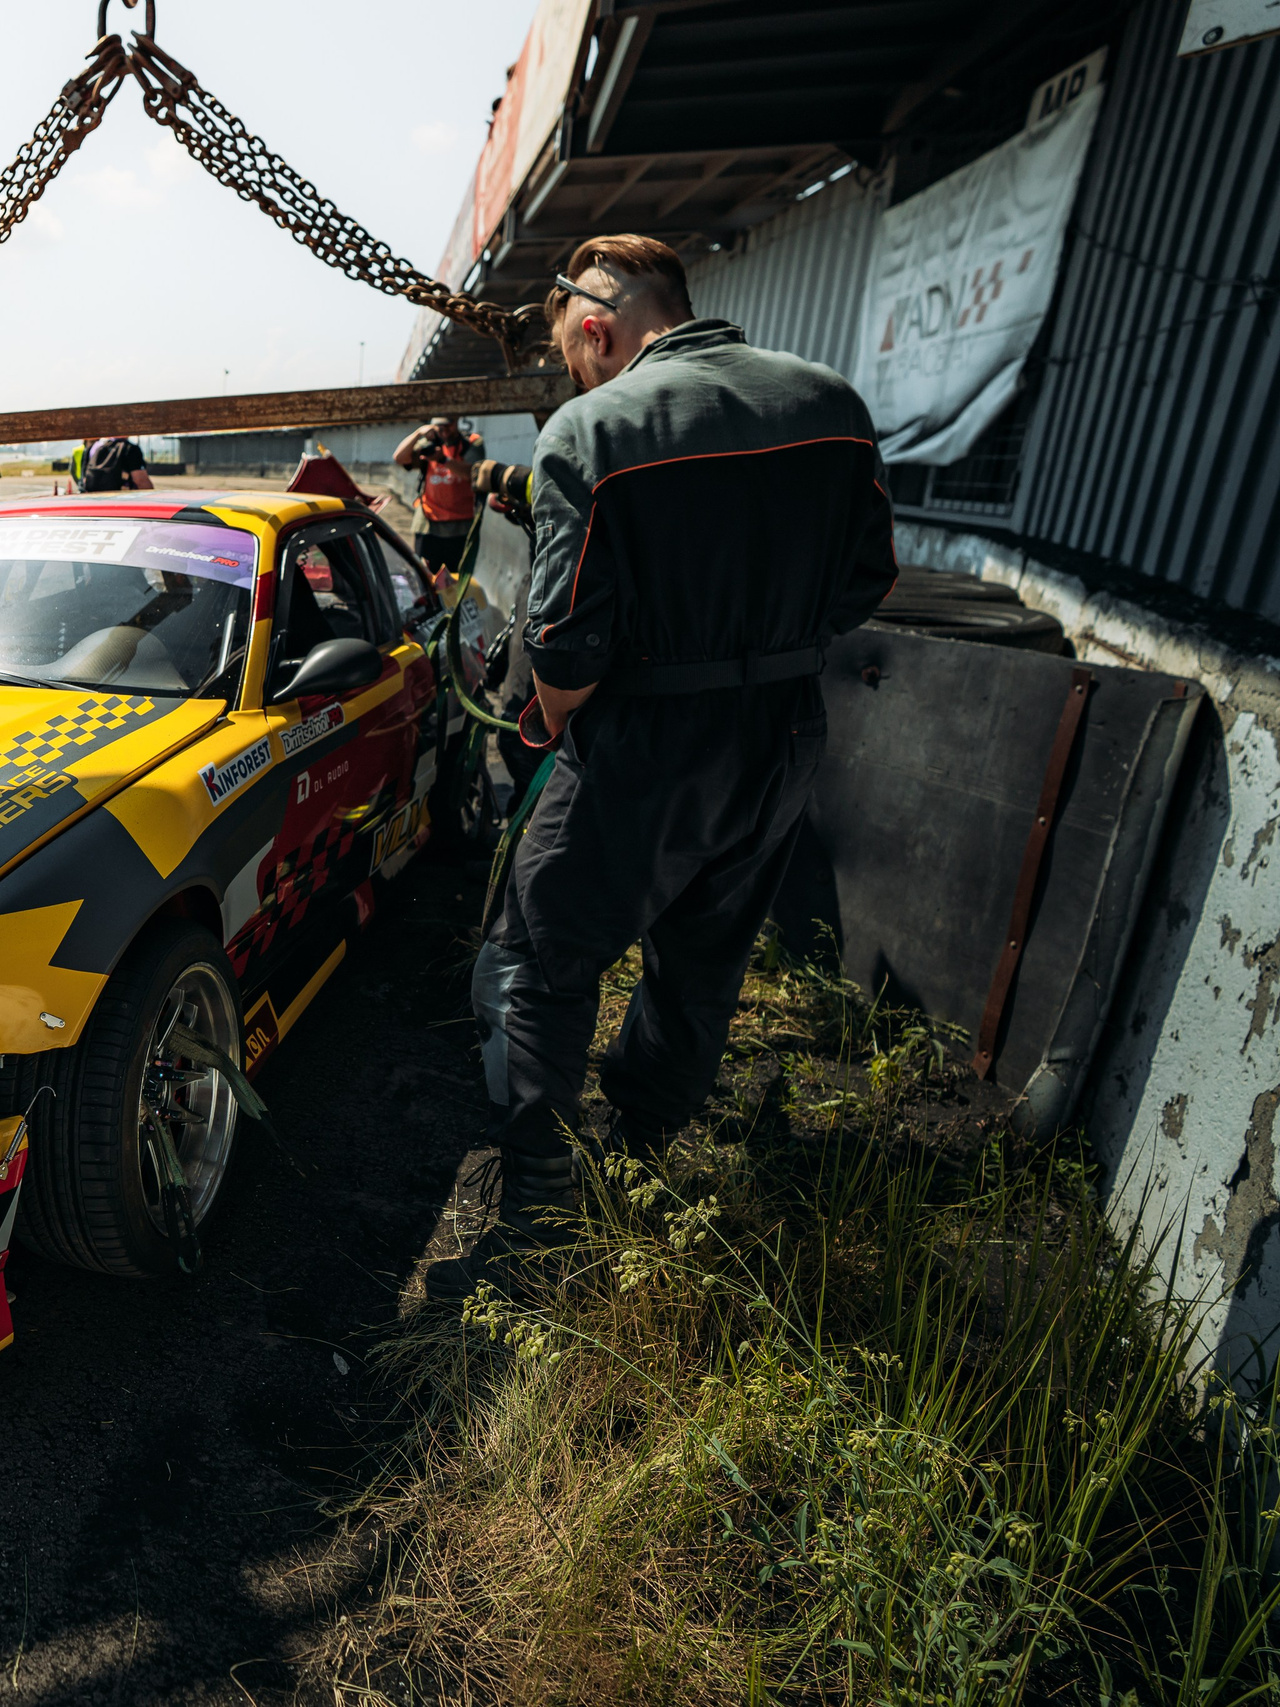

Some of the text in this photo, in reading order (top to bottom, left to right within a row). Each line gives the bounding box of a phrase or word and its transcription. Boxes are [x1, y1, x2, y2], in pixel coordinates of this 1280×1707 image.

[26, 529, 123, 542] DRIFT
[202, 740, 271, 802] KINFOREST
[327, 760, 350, 784] AUDIO
